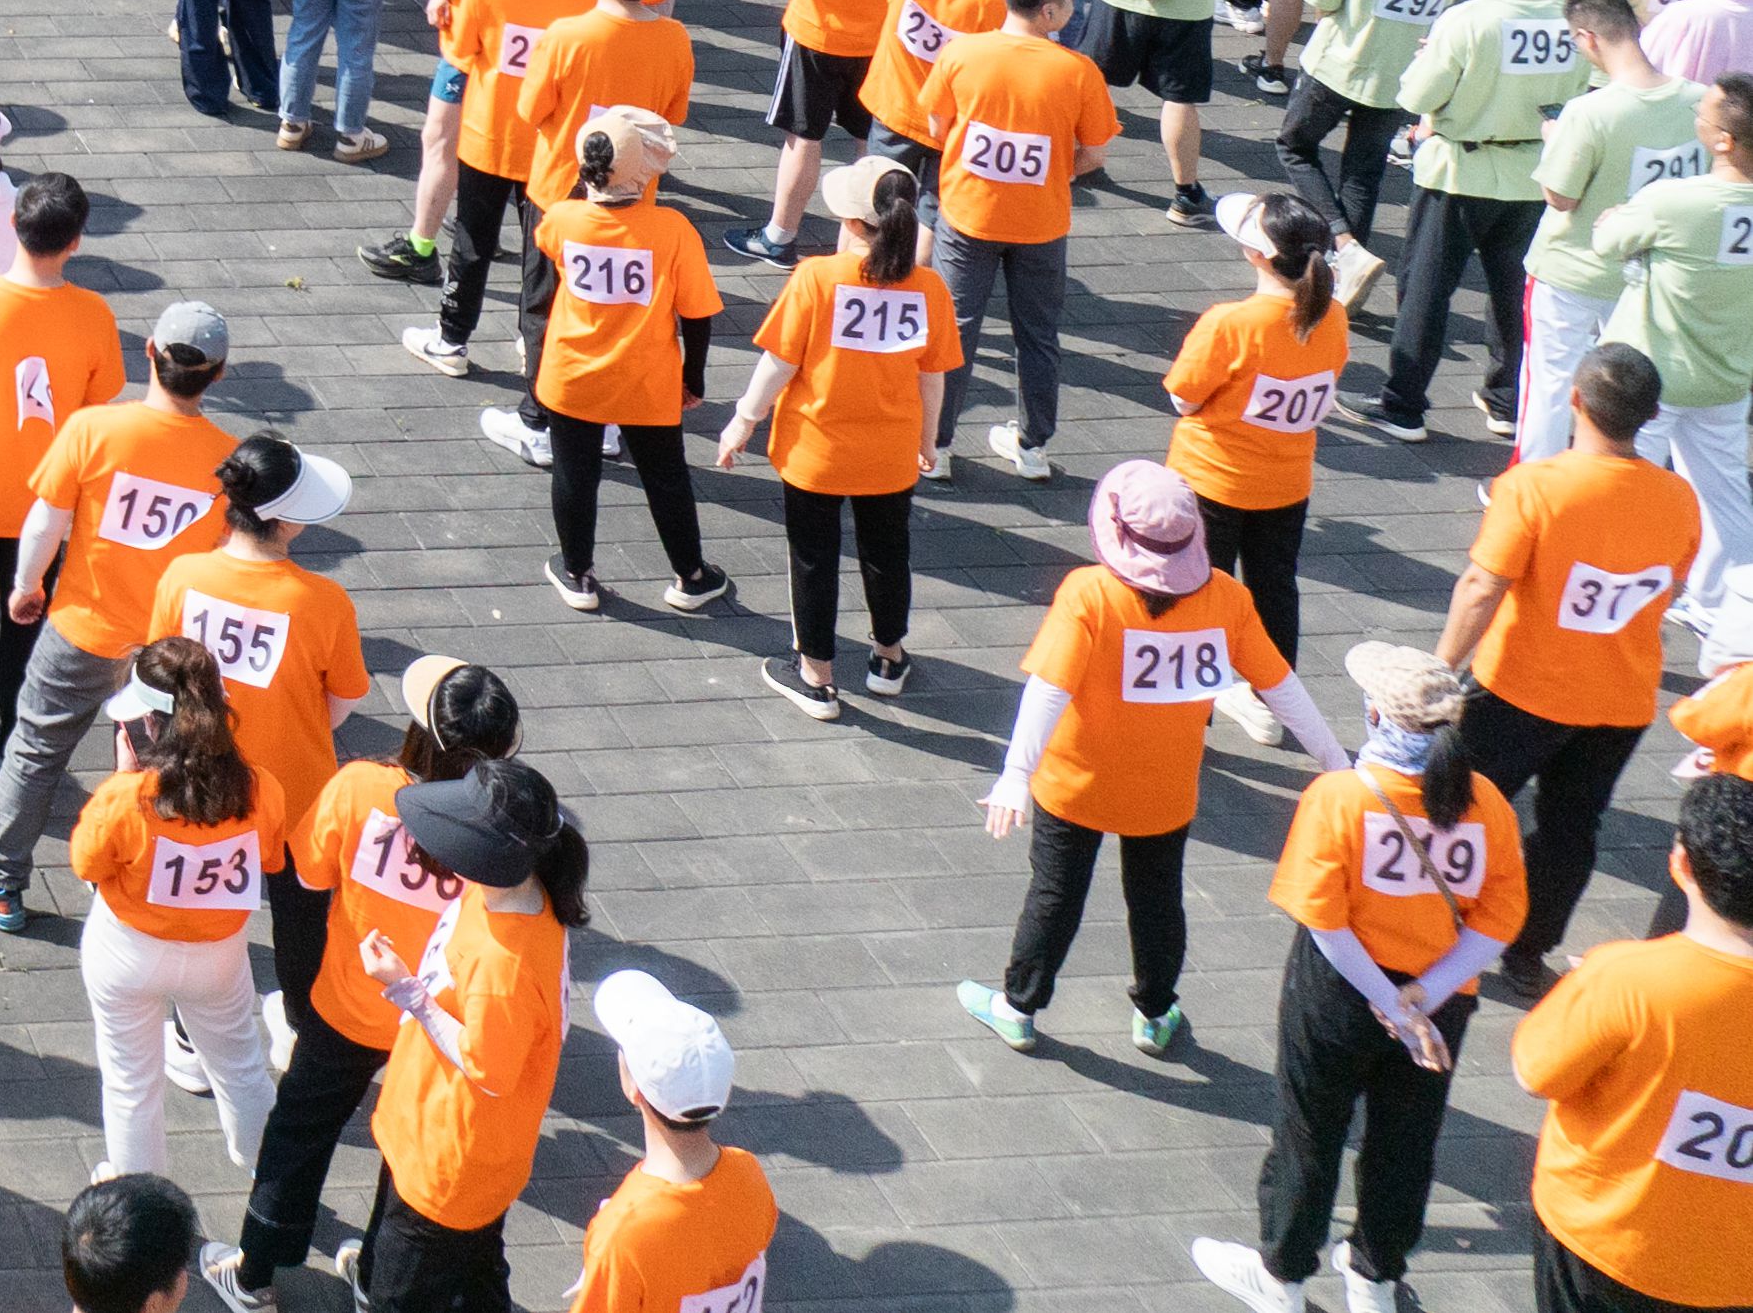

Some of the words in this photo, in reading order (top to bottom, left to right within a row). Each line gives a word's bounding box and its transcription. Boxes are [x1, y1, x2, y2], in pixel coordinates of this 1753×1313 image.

[905, 11, 951, 53] 23
[1510, 28, 1571, 65] 295
[972, 134, 1044, 178] 205
[1645, 147, 1699, 187] 291
[571, 254, 646, 295] 216
[842, 298, 920, 342] 215
[1256, 383, 1330, 423] 207
[117, 487, 199, 539] 150
[192, 609, 276, 673] 155
[1133, 642, 1223, 691] 218
[165, 847, 251, 897] 153
[1377, 830, 1475, 884] 219
[1676, 1110, 1753, 1171] 20
